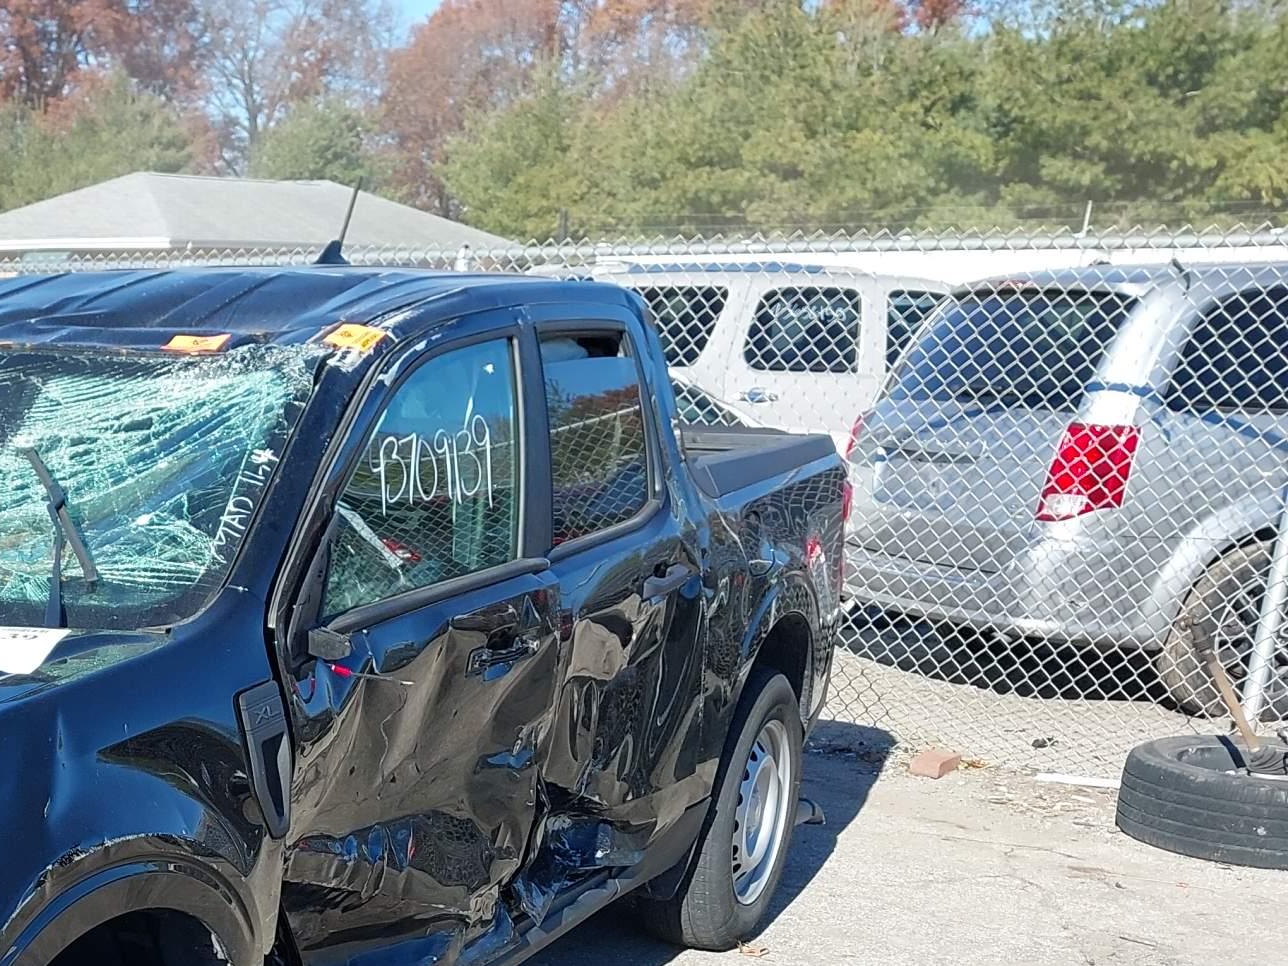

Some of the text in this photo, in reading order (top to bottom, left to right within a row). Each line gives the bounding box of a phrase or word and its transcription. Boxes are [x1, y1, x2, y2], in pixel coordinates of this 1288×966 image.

[368, 414, 494, 516] 43709139
[209, 496, 254, 564] MAD
[253, 704, 281, 725] XL
